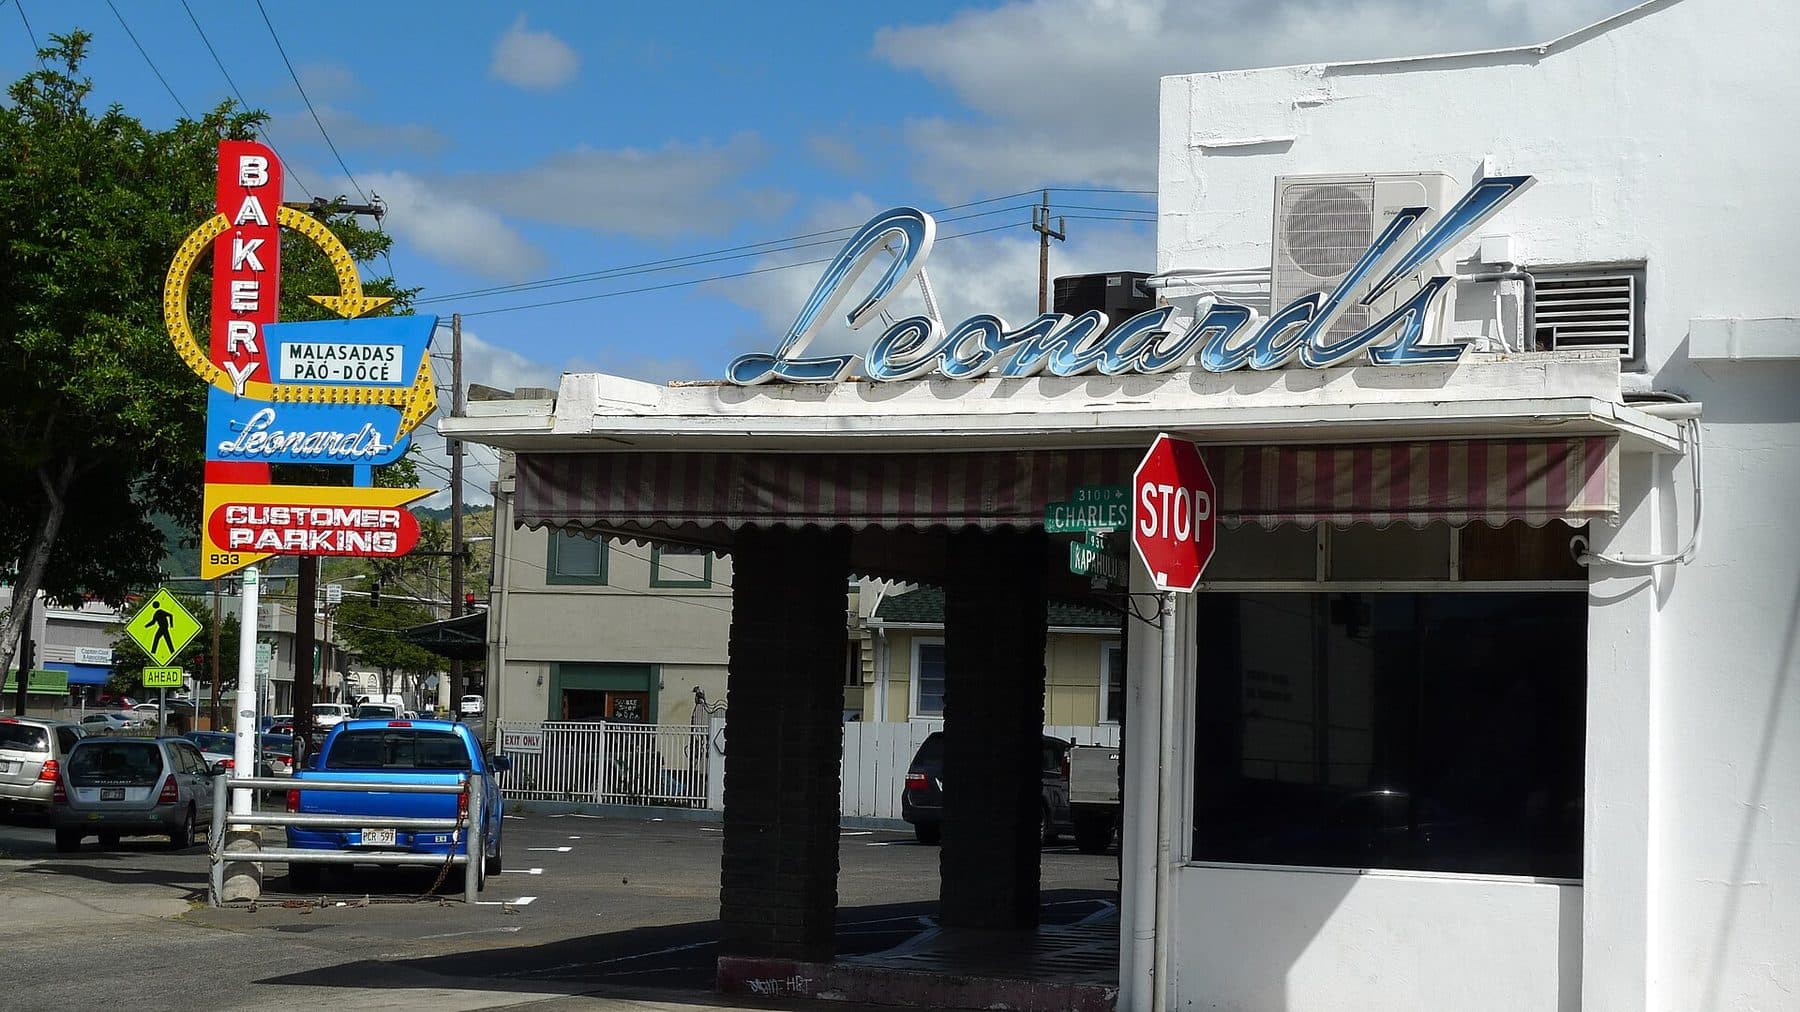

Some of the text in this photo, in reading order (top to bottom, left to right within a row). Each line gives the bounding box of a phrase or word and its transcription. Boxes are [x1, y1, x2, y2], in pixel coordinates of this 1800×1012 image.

[223, 155, 269, 396] BAKERY
[724, 175, 1537, 385] Leonard's
[290, 344, 395, 361] MALASADAS
[218, 408, 393, 456] Leonard's
[1079, 490, 1110, 501] 3100
[226, 506, 400, 529] CUSTOMER
[1055, 504, 1127, 528] CHARLES
[1140, 482, 1211, 543] STOP
[230, 529, 397, 552] PARKING
[210, 554, 240, 565] 933
[148, 671, 178, 682] AHEAD
[504, 735, 540, 747] EXIT ONLY
[363, 831, 394, 842] PCR 597
